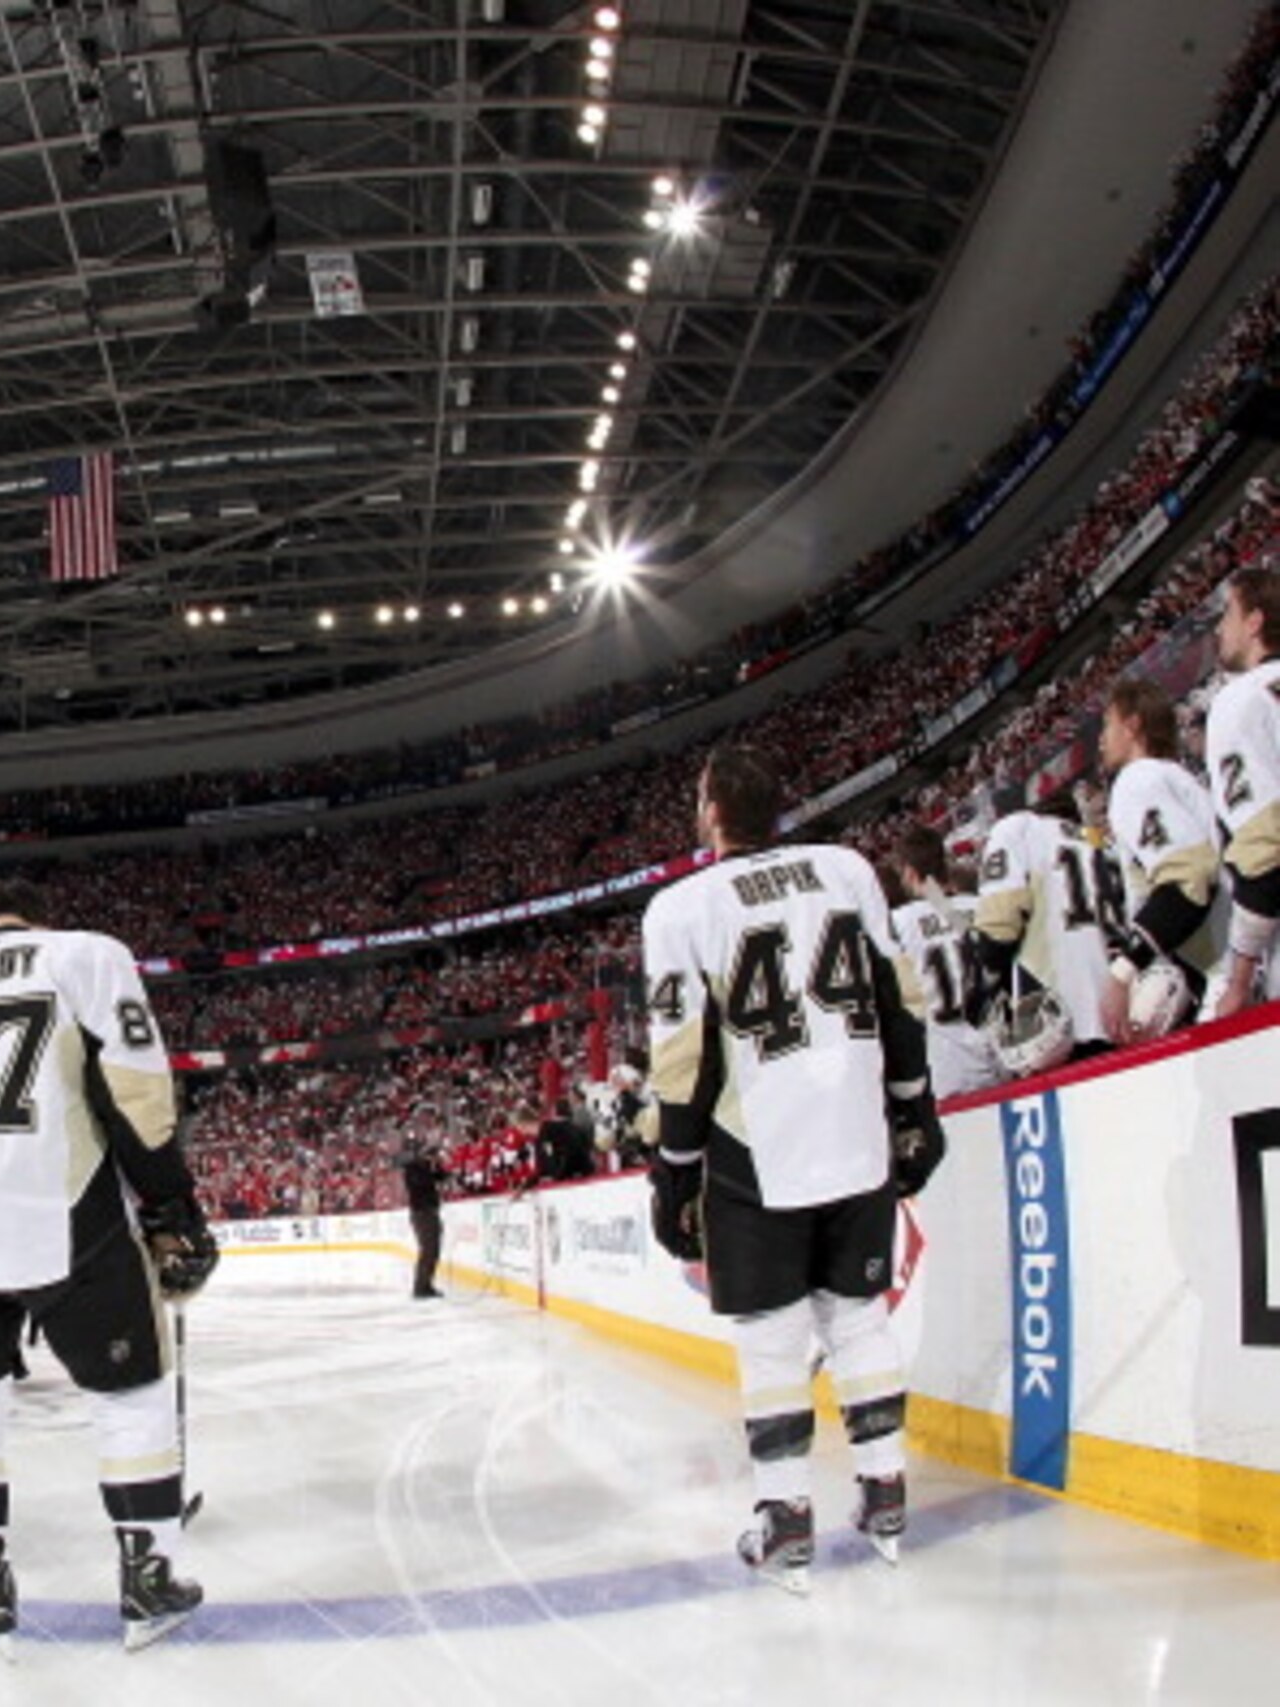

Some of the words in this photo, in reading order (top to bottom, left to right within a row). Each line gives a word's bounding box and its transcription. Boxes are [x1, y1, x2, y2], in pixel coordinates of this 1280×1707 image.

[1139, 808, 1169, 847] 4
[1220, 751, 1254, 814] 2
[722, 910, 880, 1064] 44
[1011, 1093, 1058, 1399] Reebok
